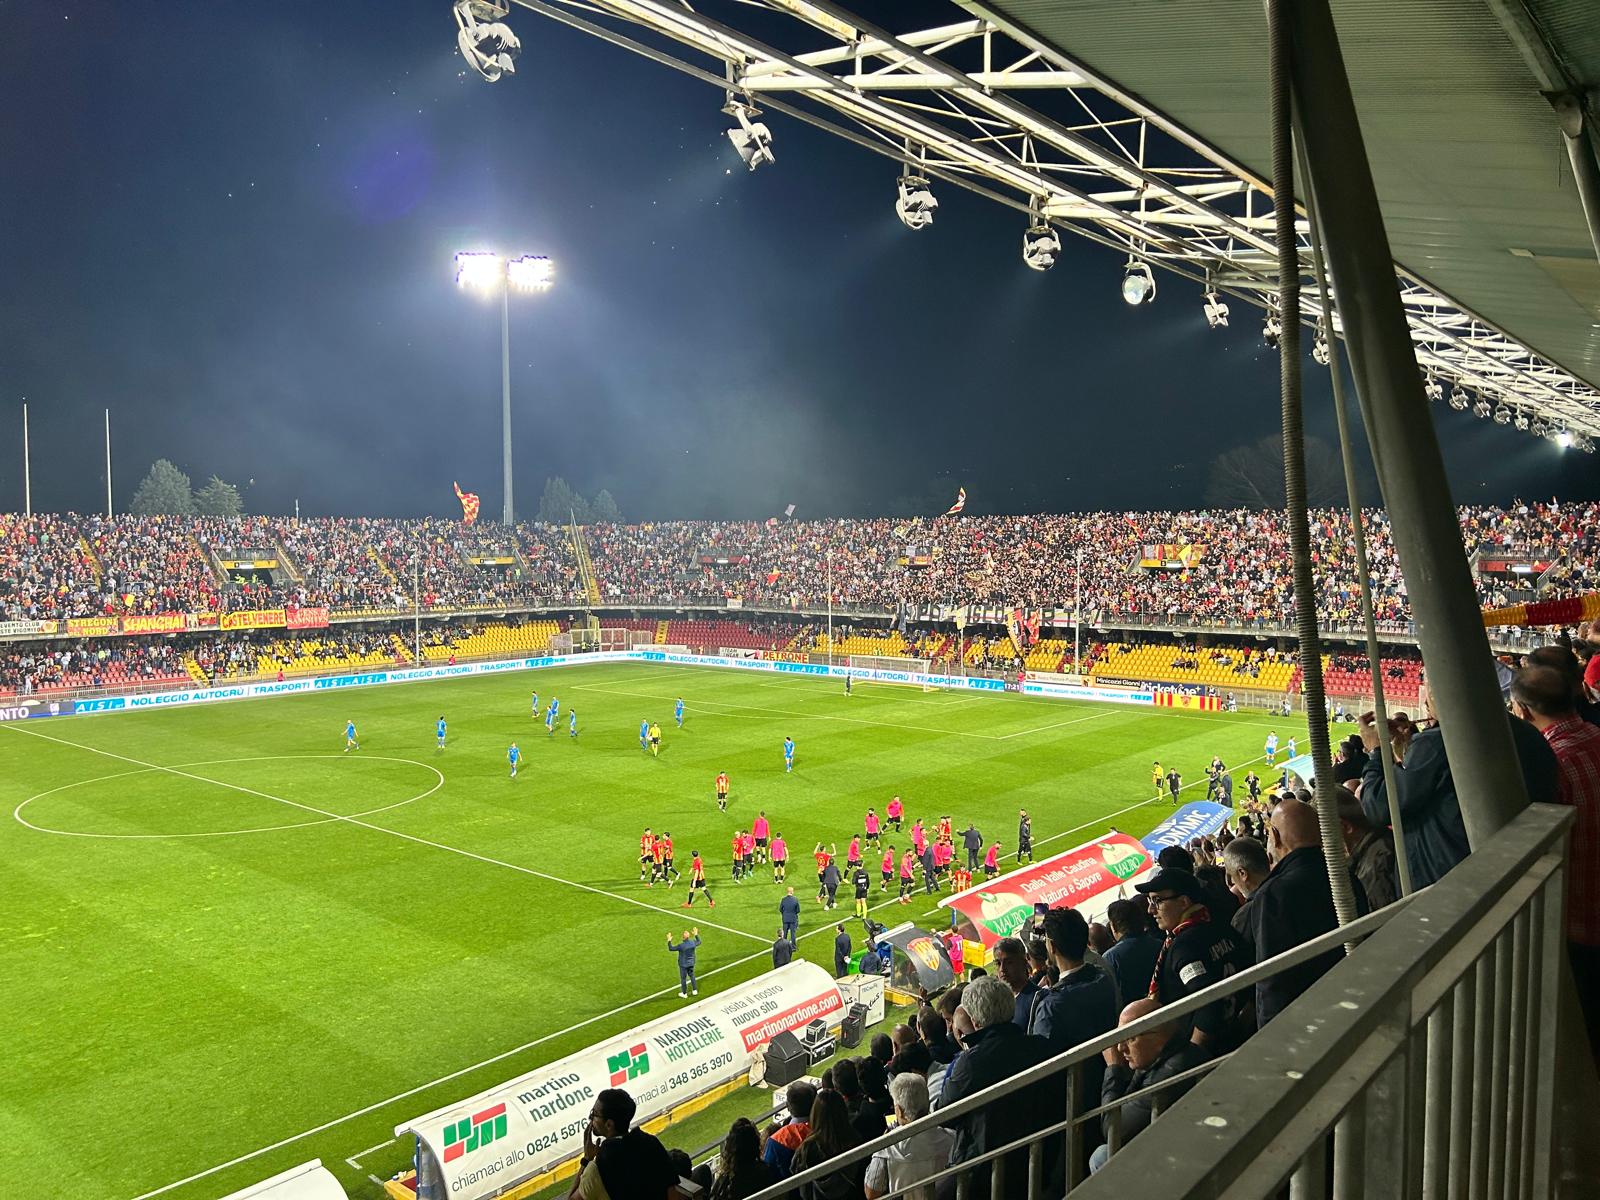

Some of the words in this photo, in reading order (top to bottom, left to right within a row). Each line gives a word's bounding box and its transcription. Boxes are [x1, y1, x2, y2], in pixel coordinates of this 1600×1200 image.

[70, 618, 117, 627] STREGONI
[83, 627, 108, 635] NORD
[124, 614, 185, 632] SHANGHAI
[222, 611, 284, 629] CASTELVENERE
[668, 655, 698, 663] NOLEGGIO
[735, 660, 771, 669] TRASPORTI
[131, 693, 189, 706] NOLEGGIO
[254, 681, 310, 694] TRASPORTI
[390, 671, 433, 680] NOLEGGIO
[480, 662, 522, 671] TRASPORTI
[1019, 878, 1047, 893] Dalla
[1041, 870, 1066, 883] Valle
[1062, 857, 1098, 875] Caudina
[1113, 857, 1139, 878] MAURO
[1039, 886, 1069, 905] Natura
[1069, 884, 1075, 894] e
[1073, 872, 1102, 890] Sapore
[993, 909, 1027, 935] MAURO
[720, 998, 748, 1015] visita
[753, 984, 783, 1001] nostro
[731, 1007, 760, 1027] nuovo
[760, 1000, 778, 1014] sito
[653, 1016, 715, 1048] NARDONE
[745, 994, 839, 1046] martinonardone.com
[665, 1027, 725, 1062] HOTELLERIE
[517, 1072, 580, 1105] martino
[660, 1083, 669, 1095] al
[669, 1072, 689, 1089] 348
[690, 1063, 709, 1080] 365
[710, 1052, 733, 1070] 3970
[529, 1085, 594, 1122] nardone
[452, 1160, 504, 1192] chiamaci
[506, 1150, 525, 1167] allo
[526, 1132, 558, 1156] 0824
[560, 1118, 589, 1140] 5876
